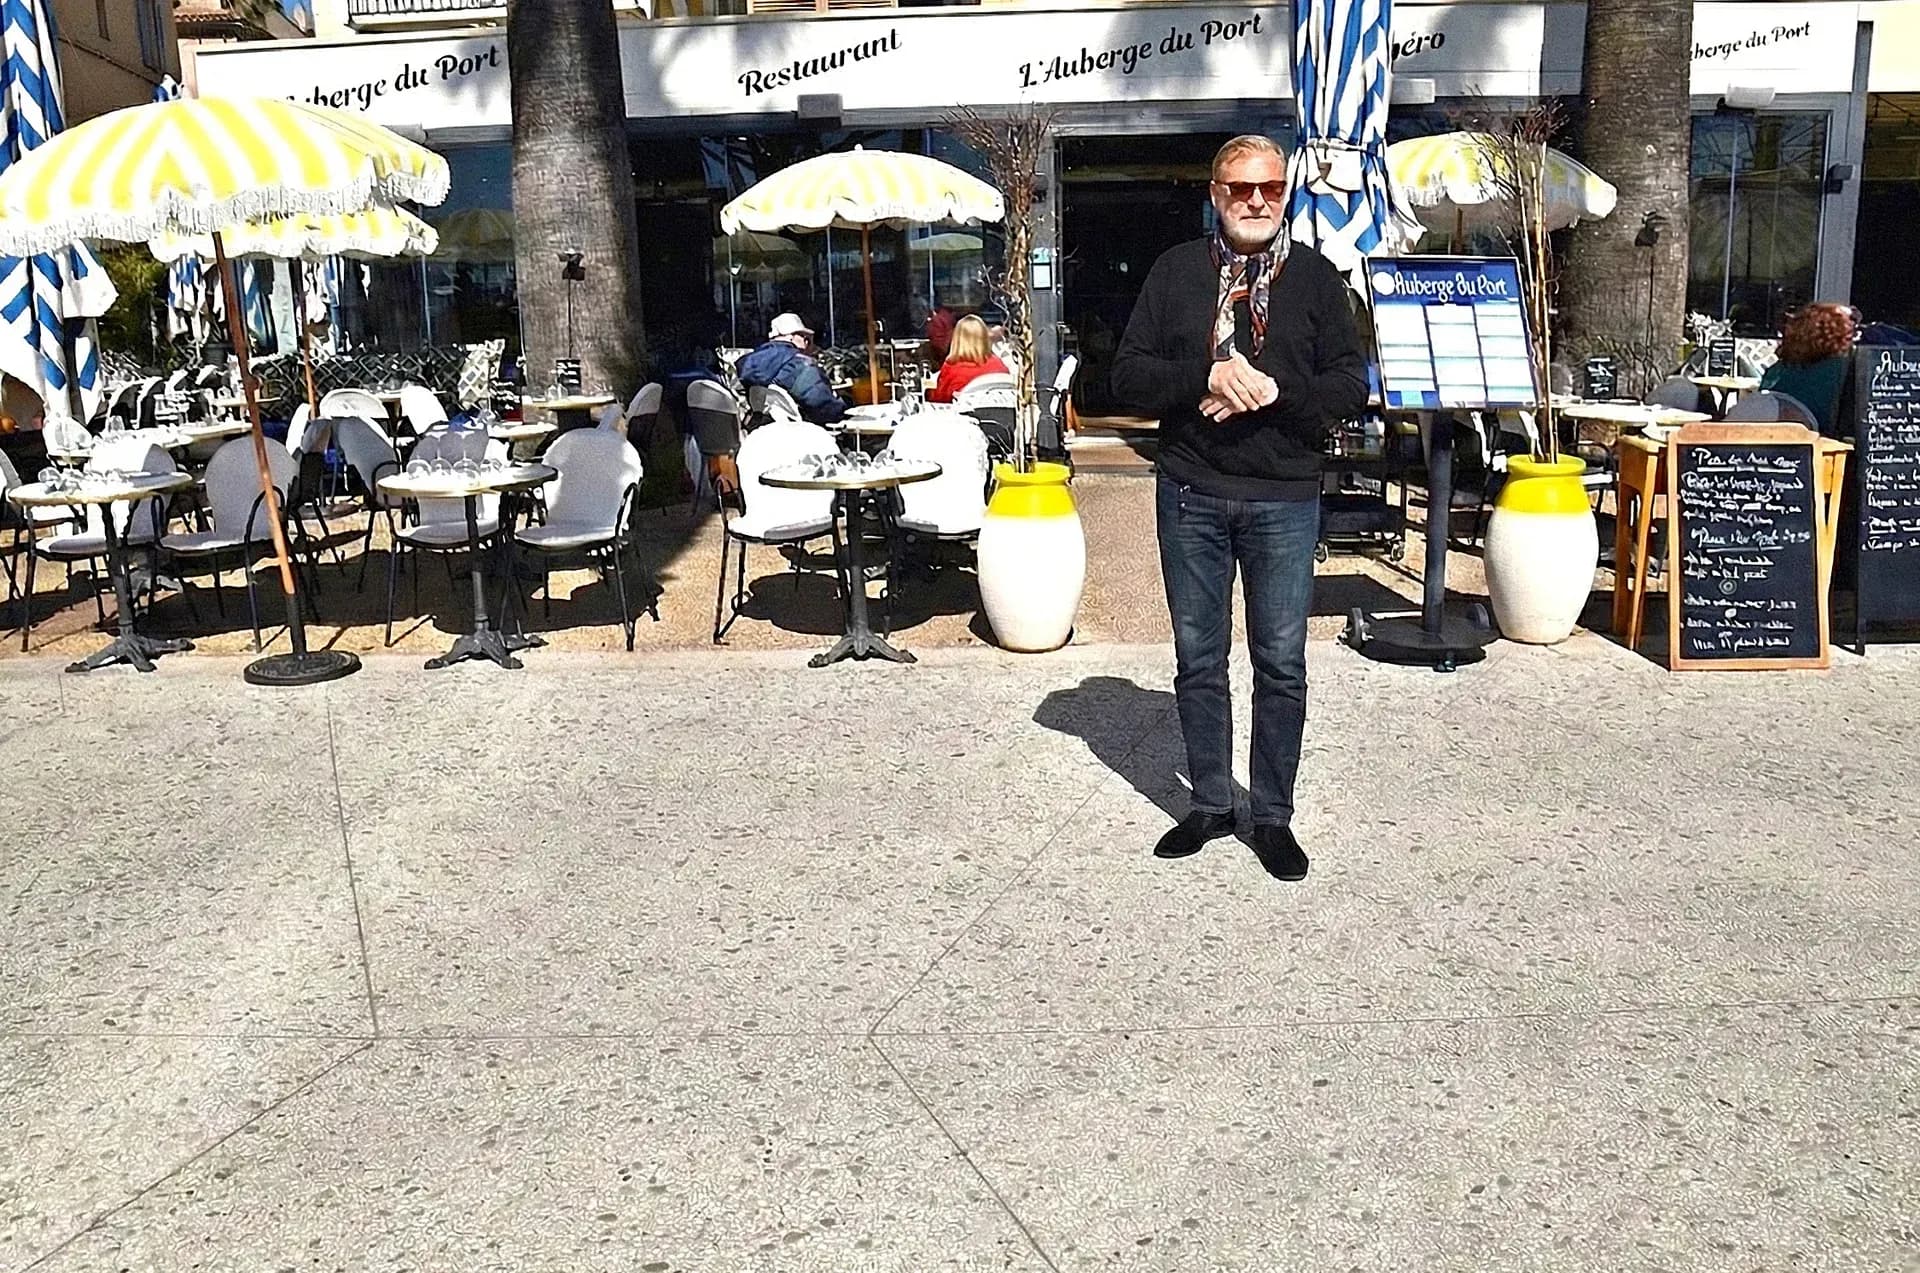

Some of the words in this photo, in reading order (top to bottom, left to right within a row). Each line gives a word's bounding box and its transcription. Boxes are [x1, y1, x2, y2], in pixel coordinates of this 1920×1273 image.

[738, 29, 903, 96] Restaurant
[1019, 43, 1152, 88] L'Auberge
[1159, 27, 1195, 55] du
[1200, 13, 1264, 45] Port
[1745, 31, 1768, 48] du
[1771, 21, 1810, 42] Port
[287, 80, 387, 112] berge
[394, 63, 430, 92] du
[434, 45, 501, 80] Port
[1395, 271, 1455, 303] Auberge
[1455, 272, 1477, 296] du
[1477, 274, 1508, 296] Port
